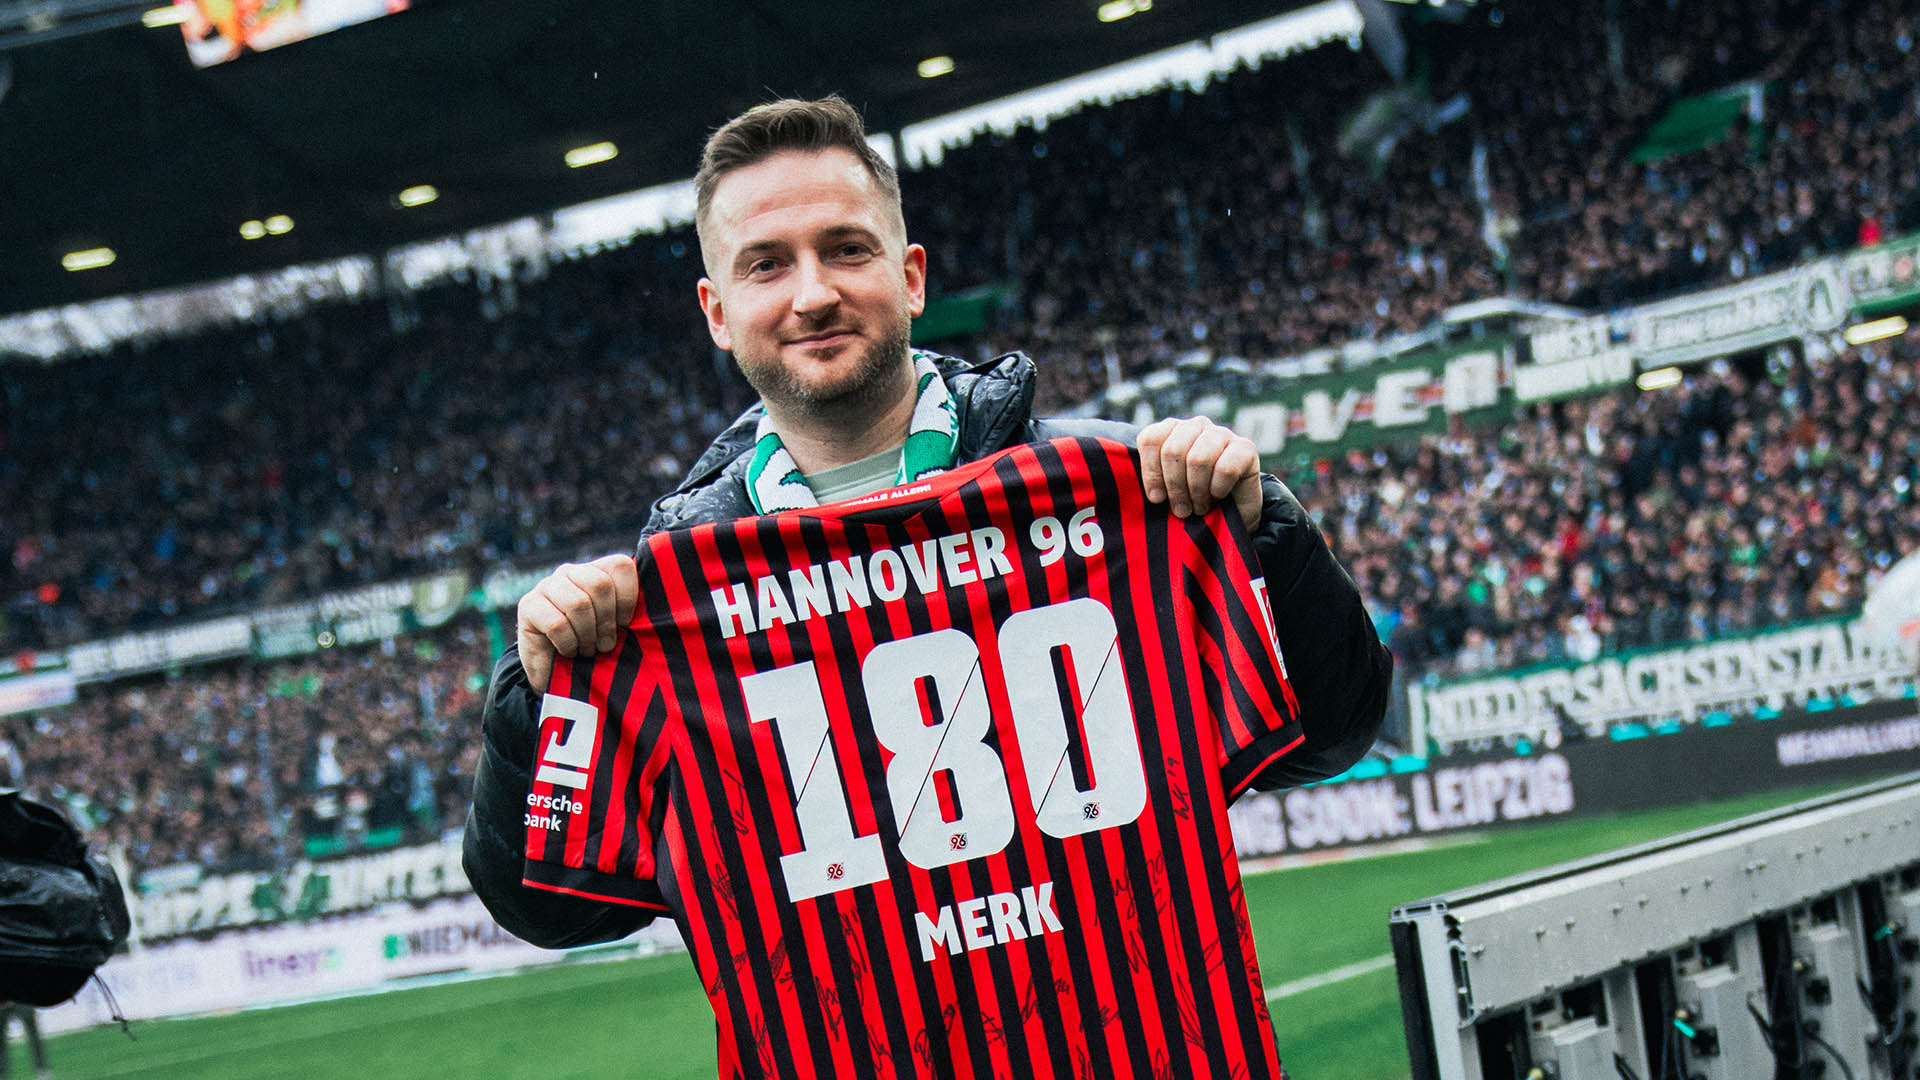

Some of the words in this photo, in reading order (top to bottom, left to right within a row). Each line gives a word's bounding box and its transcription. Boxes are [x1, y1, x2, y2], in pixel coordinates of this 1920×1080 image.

[710, 526, 1015, 639] HANNOVER
[1029, 505, 1105, 568] 96
[740, 597, 1148, 903] 180
[526, 792, 583, 815] ersche
[1083, 803, 1100, 819] 96
[1412, 753, 1575, 833] LEIPZIG
[950, 833, 967, 850] 96
[827, 863, 844, 880] 96
[914, 882, 1064, 962] MERK
